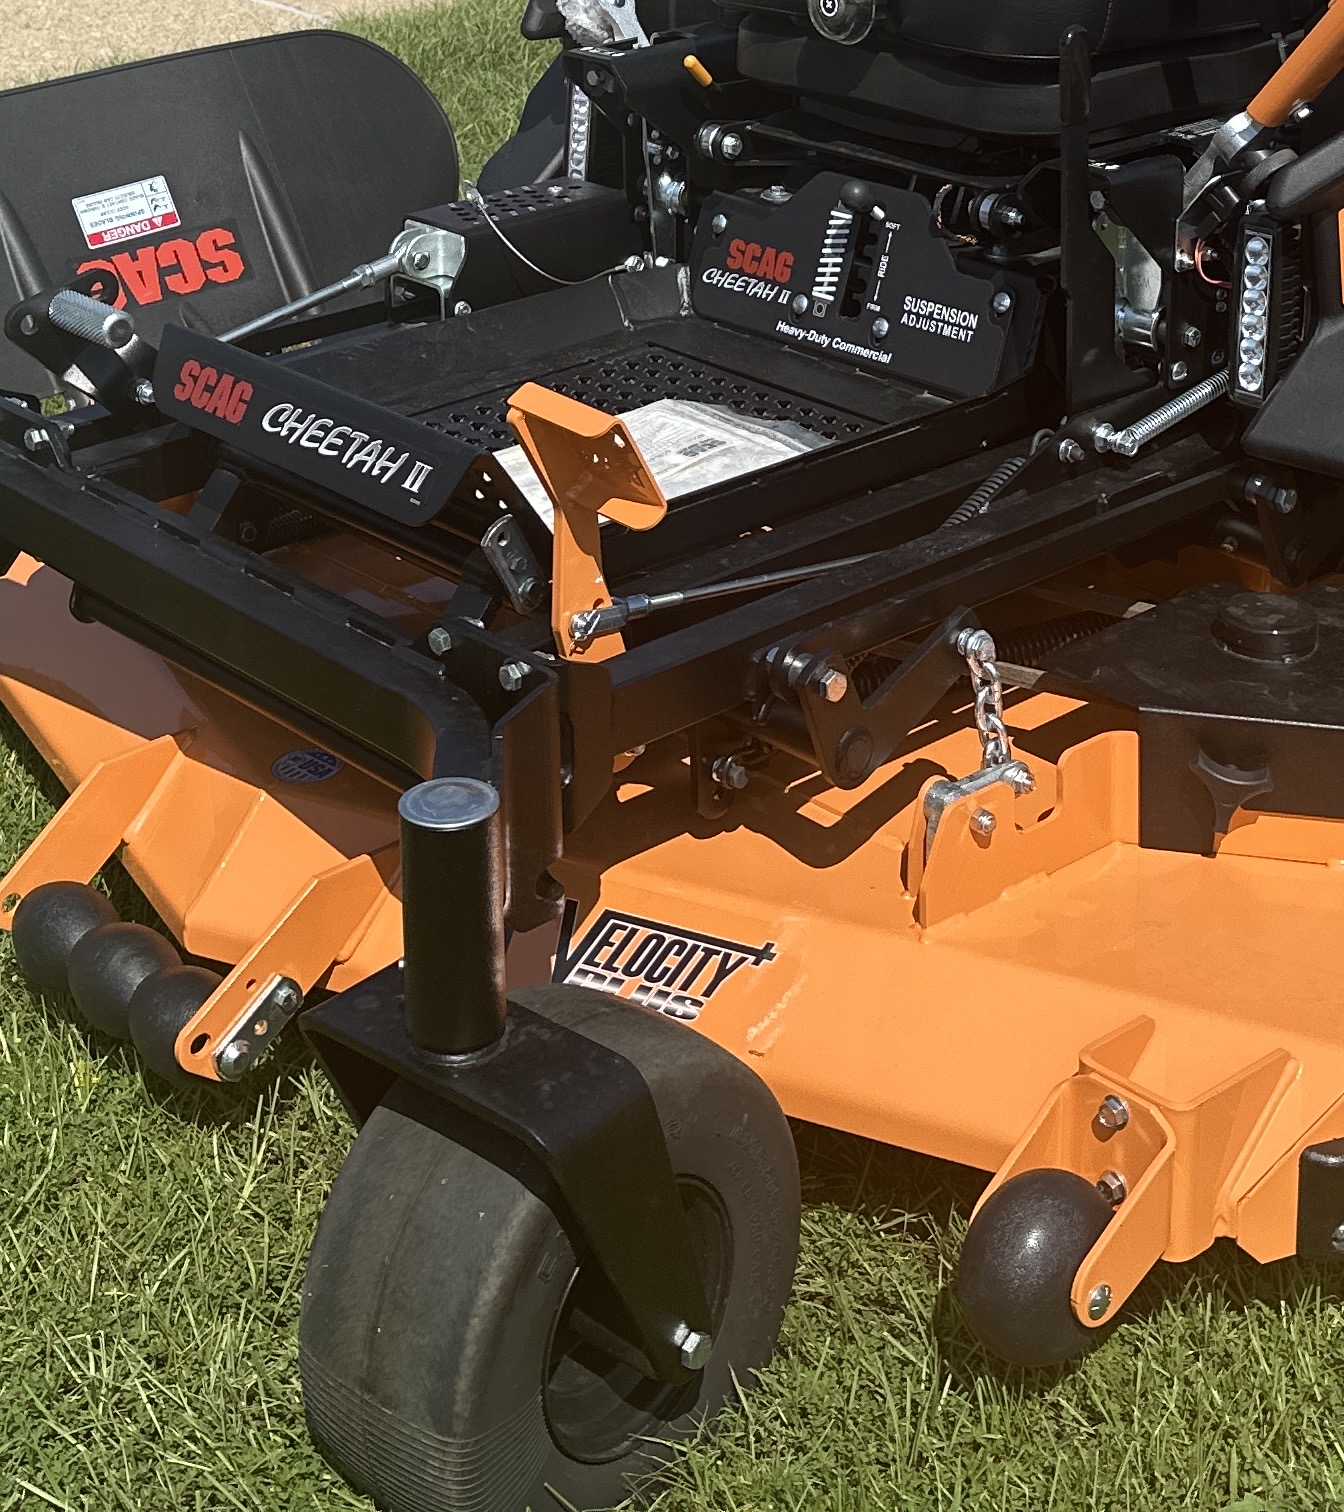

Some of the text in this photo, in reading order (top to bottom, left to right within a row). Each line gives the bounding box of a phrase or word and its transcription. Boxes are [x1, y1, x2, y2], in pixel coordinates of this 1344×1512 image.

[103, 220, 151, 242] DANGER
[885, 221, 901, 230] SOFT
[726, 238, 795, 284] SCAG
[877, 255, 889, 278] RIDE
[702, 268, 792, 305] CHEETAH II
[866, 302, 881, 312] FIRM
[903, 296, 978, 329] SUSPENSION
[776, 320, 893, 364] Heavy-Duty Commercial
[900, 313, 974, 343] ADJUSTMENT
[173, 359, 433, 493] SCAG CHEETAH II
